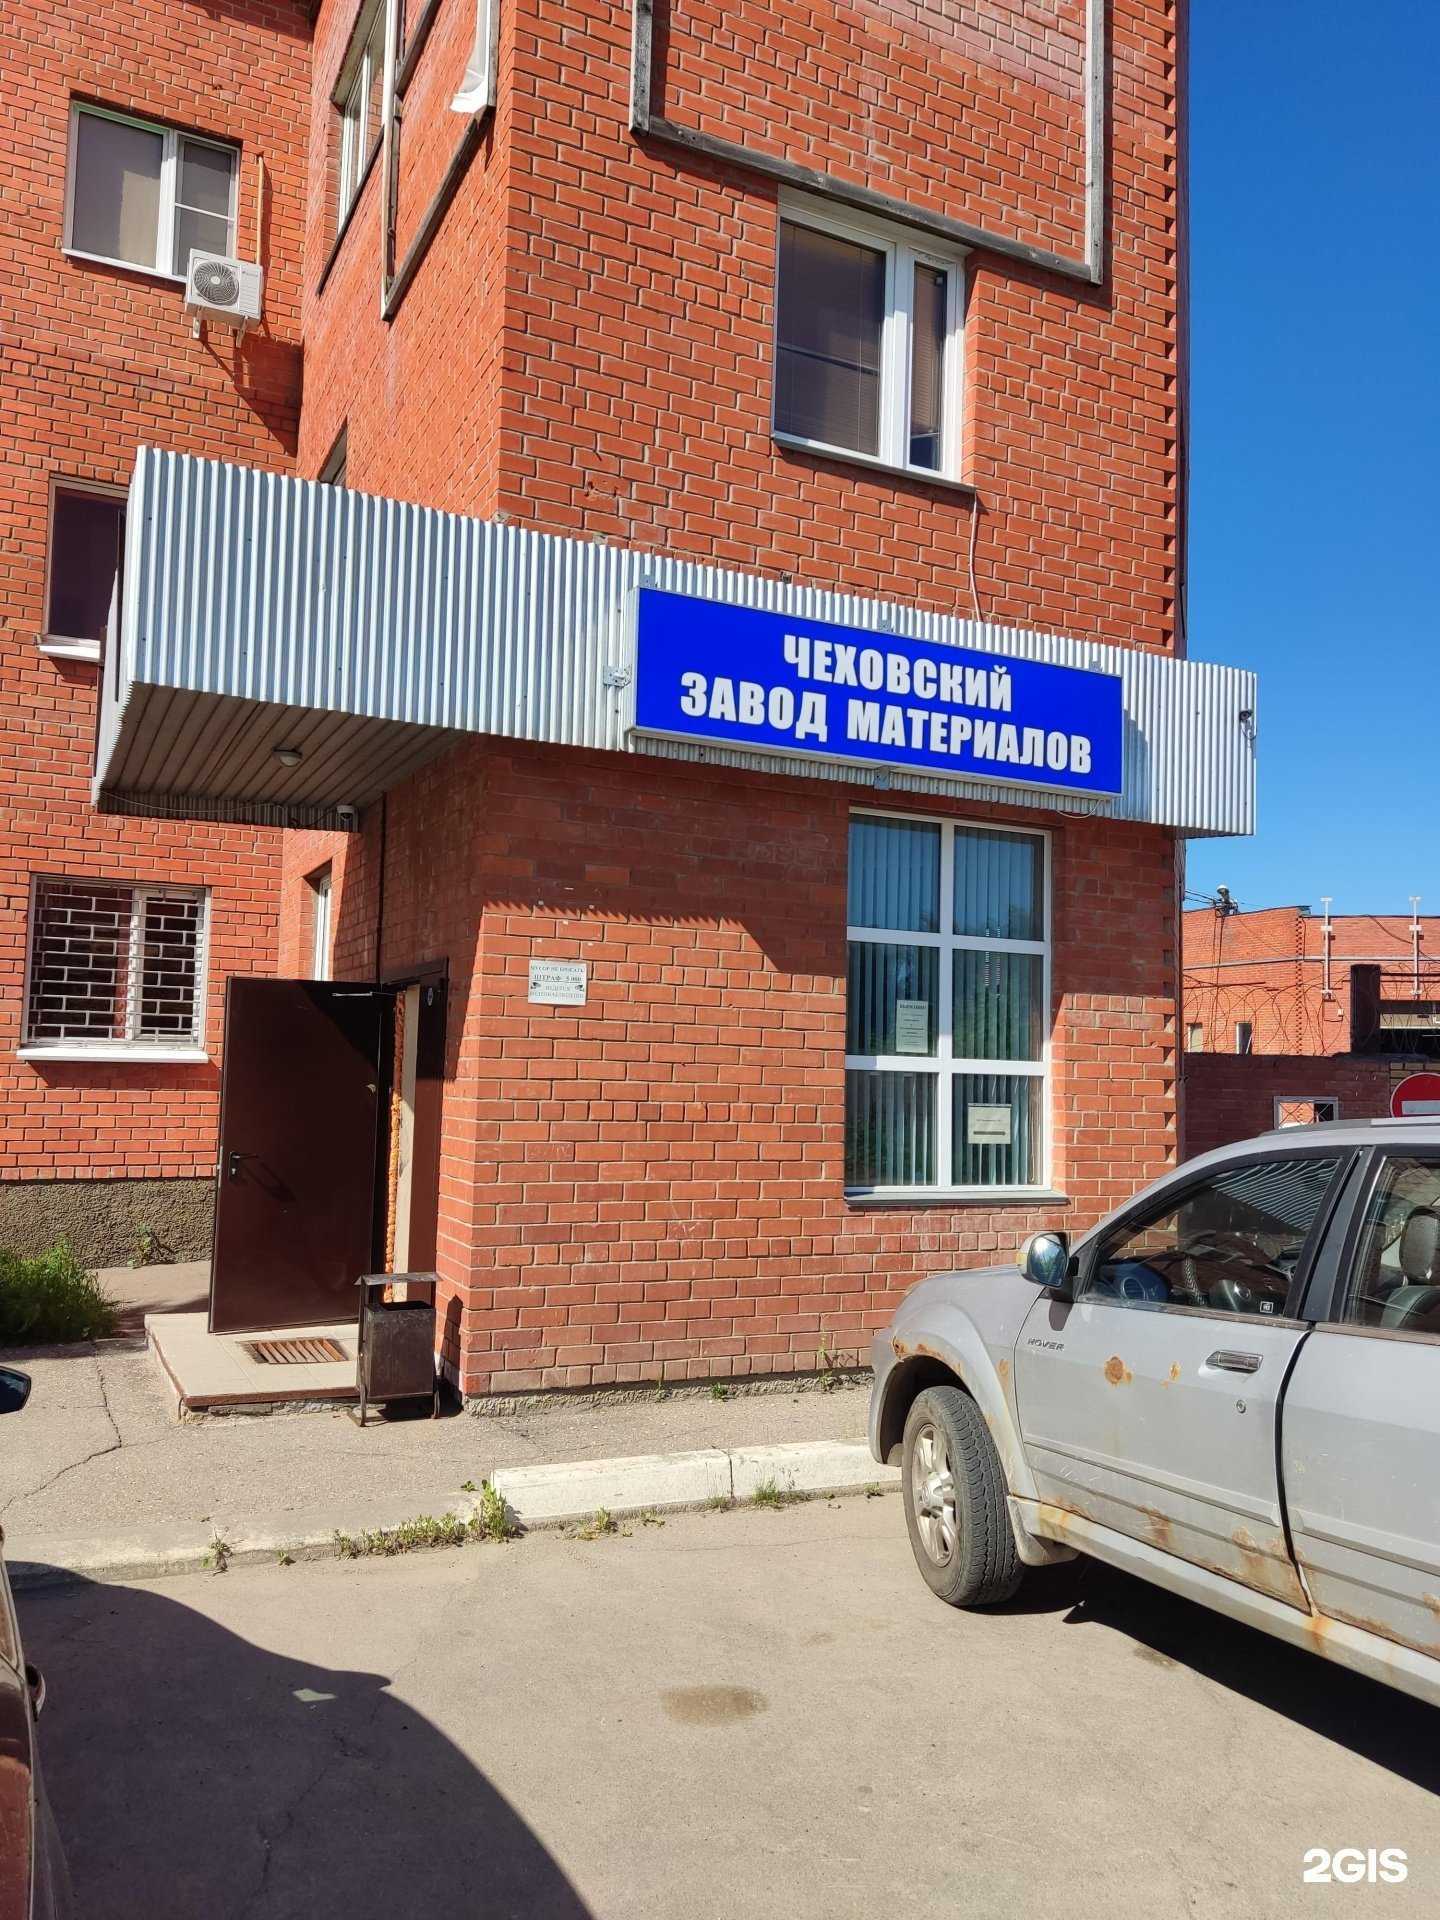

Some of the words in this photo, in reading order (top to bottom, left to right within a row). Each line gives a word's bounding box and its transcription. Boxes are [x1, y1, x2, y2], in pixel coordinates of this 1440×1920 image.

[783, 634, 1012, 712] ЧЕХОВСКИЙ
[680, 671, 828, 743] ЗАВОД
[847, 698, 1092, 774] МАТЕРИАЛОВ
